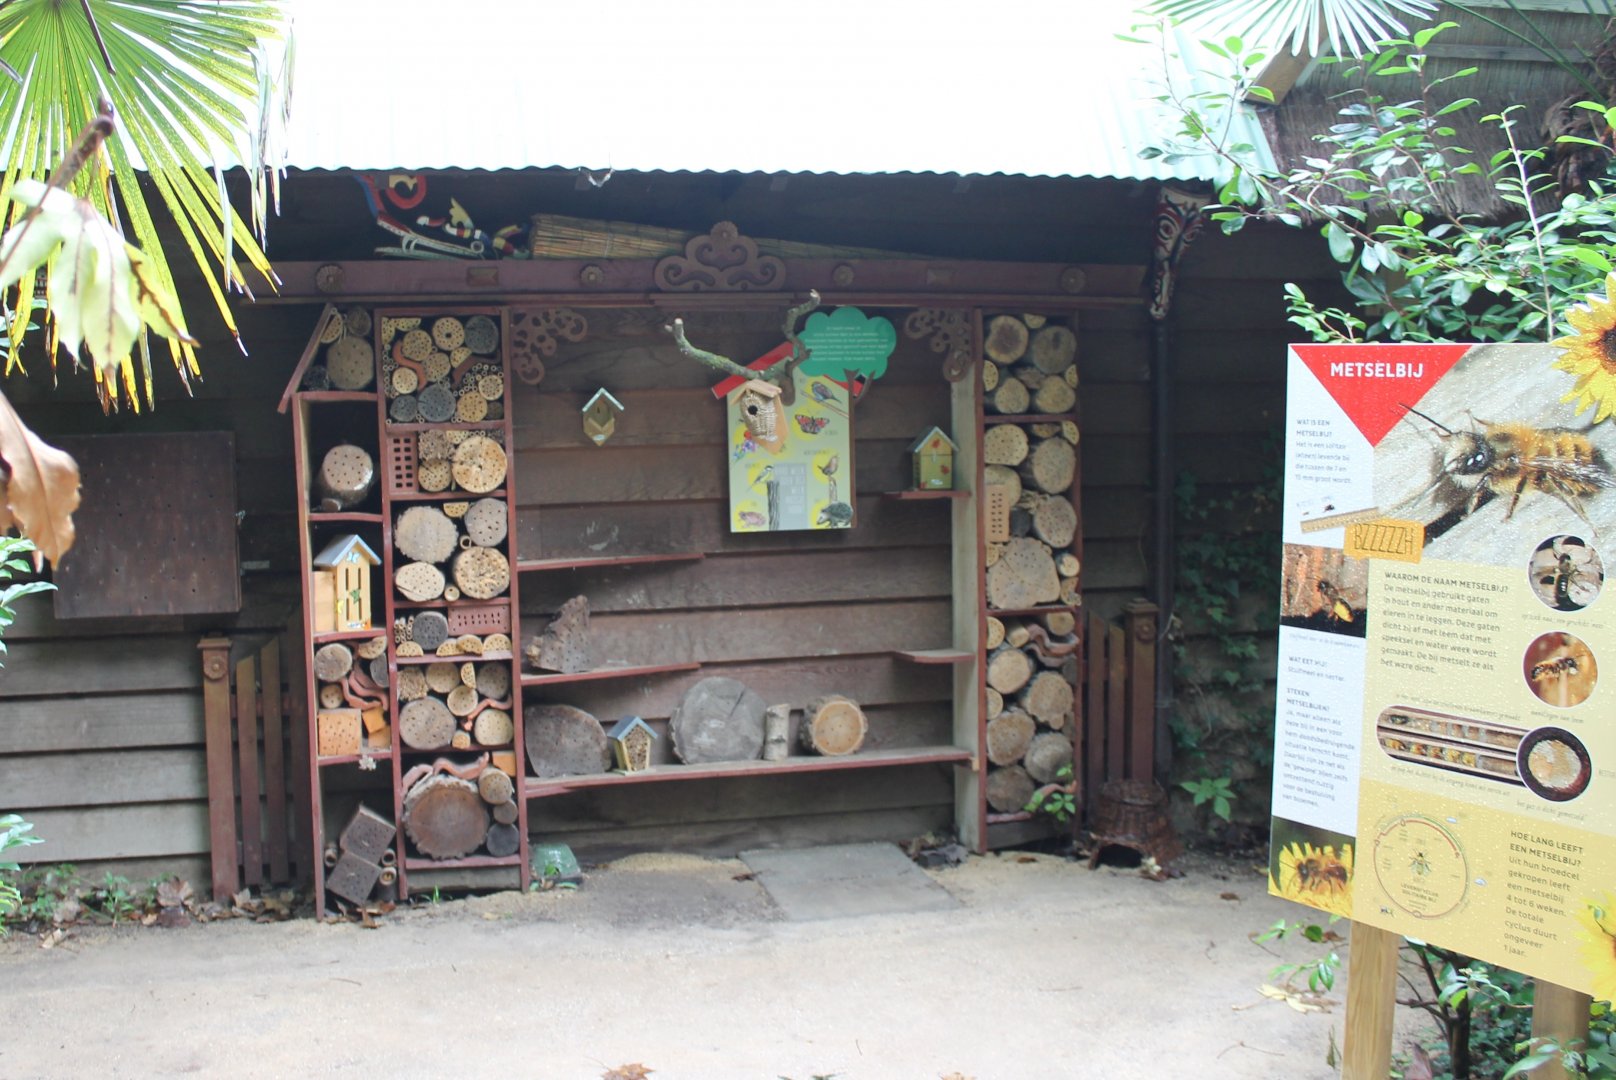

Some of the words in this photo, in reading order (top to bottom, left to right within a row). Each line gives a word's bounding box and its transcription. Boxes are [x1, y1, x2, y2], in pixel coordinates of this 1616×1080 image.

[1330, 362, 1423, 378] METSELBIJ
[1384, 571, 1419, 582] WAAROM
[1421, 576, 1432, 584] DE
[1433, 578, 1457, 586] NAAM
[1459, 580, 1509, 593] METSELBIJ?
[1395, 585, 1430, 598] metselbij
[1431, 590, 1465, 601] gebruikt
[1466, 594, 1490, 604] gaten
[1382, 621, 1401, 630] dicht
[1422, 627, 1438, 636] met
[1459, 632, 1474, 641] dat
[1475, 635, 1491, 644] met
[1456, 619, 1475, 628] Deze
[1477, 622, 1501, 632] gaten
[1425, 641, 1449, 650] water
[1472, 649, 1497, 658] wordt
[1510, 830, 1529, 841] HOE
[1530, 835, 1554, 847] LANG
[1556, 841, 1584, 854] LEEFT
[1510, 843, 1527, 853] EEN
[1529, 848, 1582, 867] METSELBIJ?
[1509, 855, 1521, 865] Uit
[1523, 859, 1540, 870] hun
[1541, 863, 1580, 881] broedcel
[1508, 869, 1548, 886] gekropen
[1549, 878, 1571, 892] leeft
[1507, 882, 1522, 892] een
[1524, 886, 1564, 904] metselbij
[1505, 906, 1517, 916] De
[1518, 909, 1545, 924] totale
[1506, 893, 1512, 901] 4
[1513, 896, 1527, 906] tot
[1528, 899, 1535, 908] 6
[1536, 902, 1567, 917] weken.
[1504, 918, 1531, 933] cyclus
[1533, 927, 1558, 941] duurt
[1504, 933, 1544, 949] ongeveer
[1508, 945, 1528, 958] jaar.
